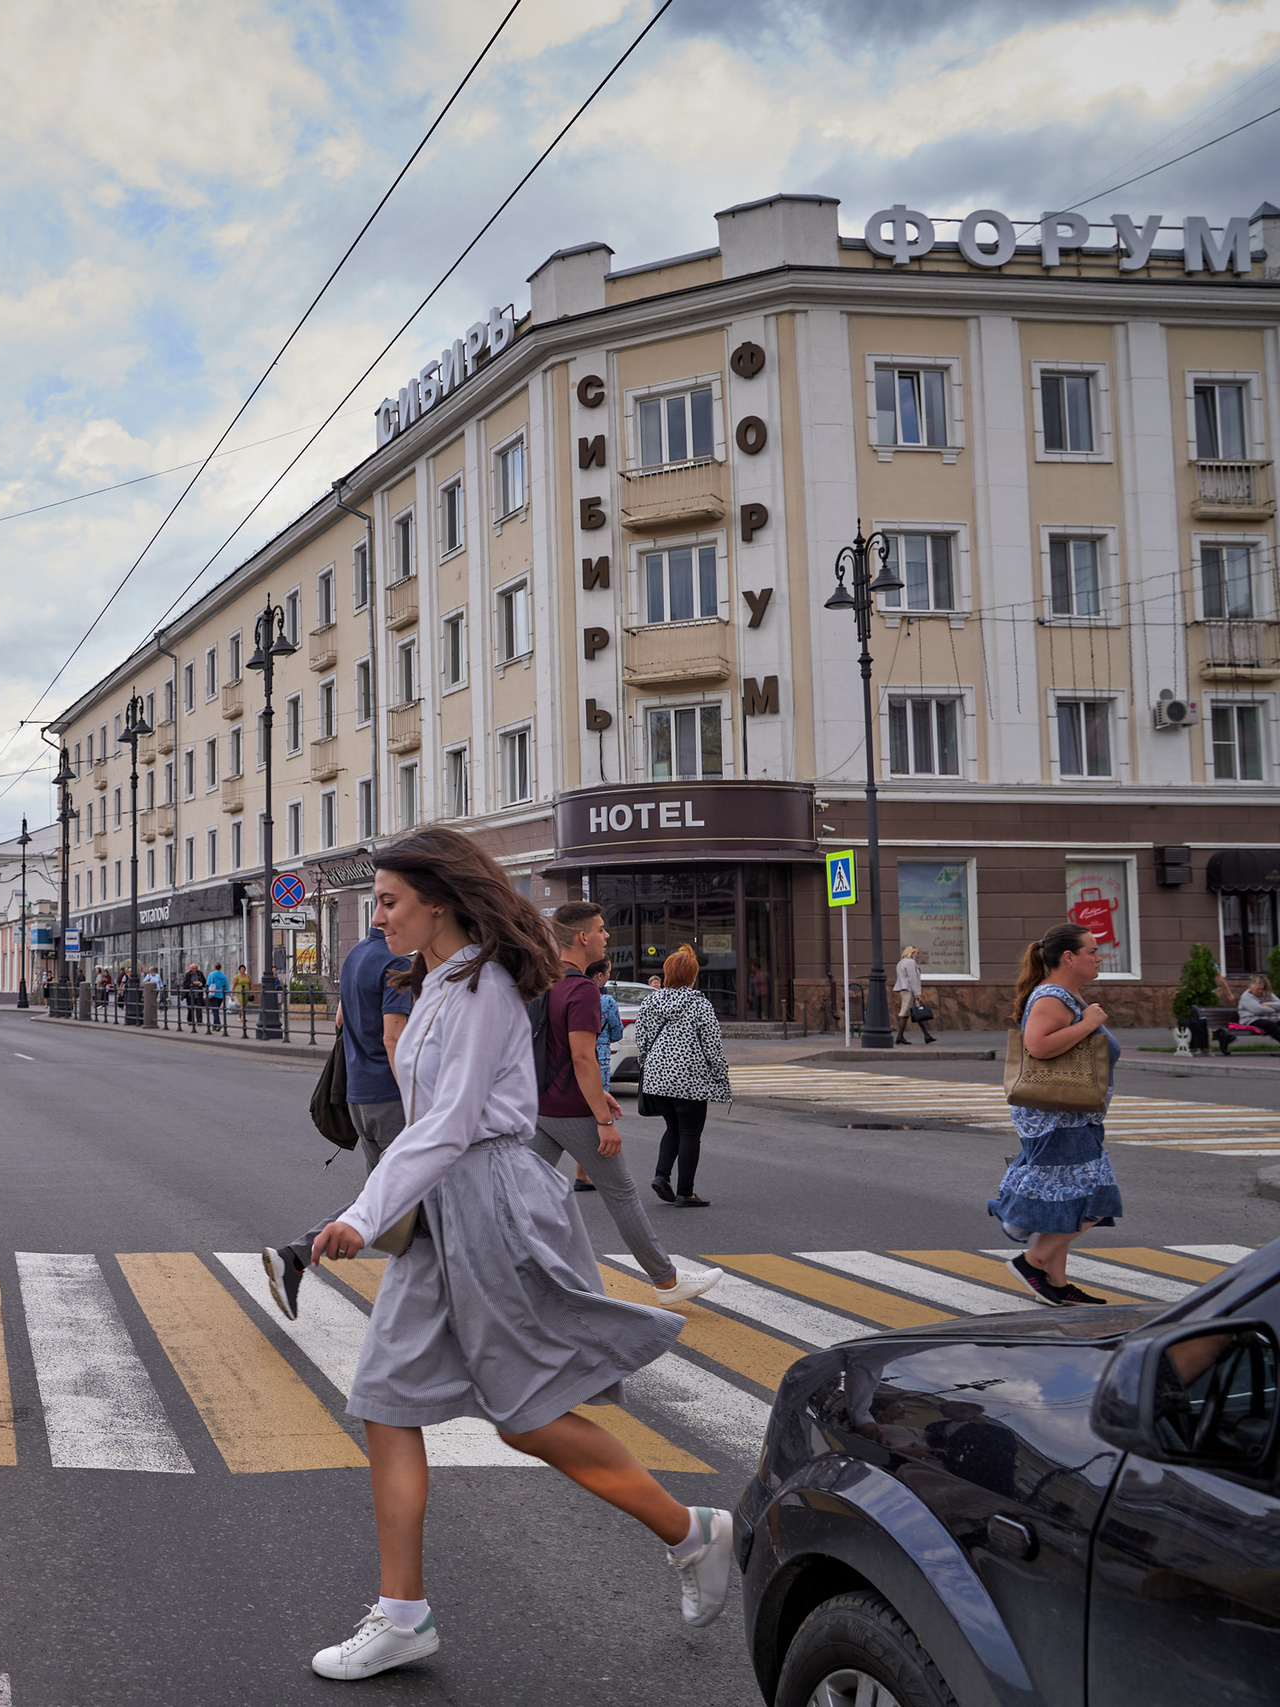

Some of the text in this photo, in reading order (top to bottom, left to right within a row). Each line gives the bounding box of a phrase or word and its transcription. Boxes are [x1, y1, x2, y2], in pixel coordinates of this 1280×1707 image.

[864, 204, 1252, 274] ФОРУМ
[380, 307, 515, 446] СИБИРЬ
[577, 375, 612, 731] СИБИРЬ
[730, 341, 779, 715] ФОРУМ
[589, 800, 705, 833] HOTEL
